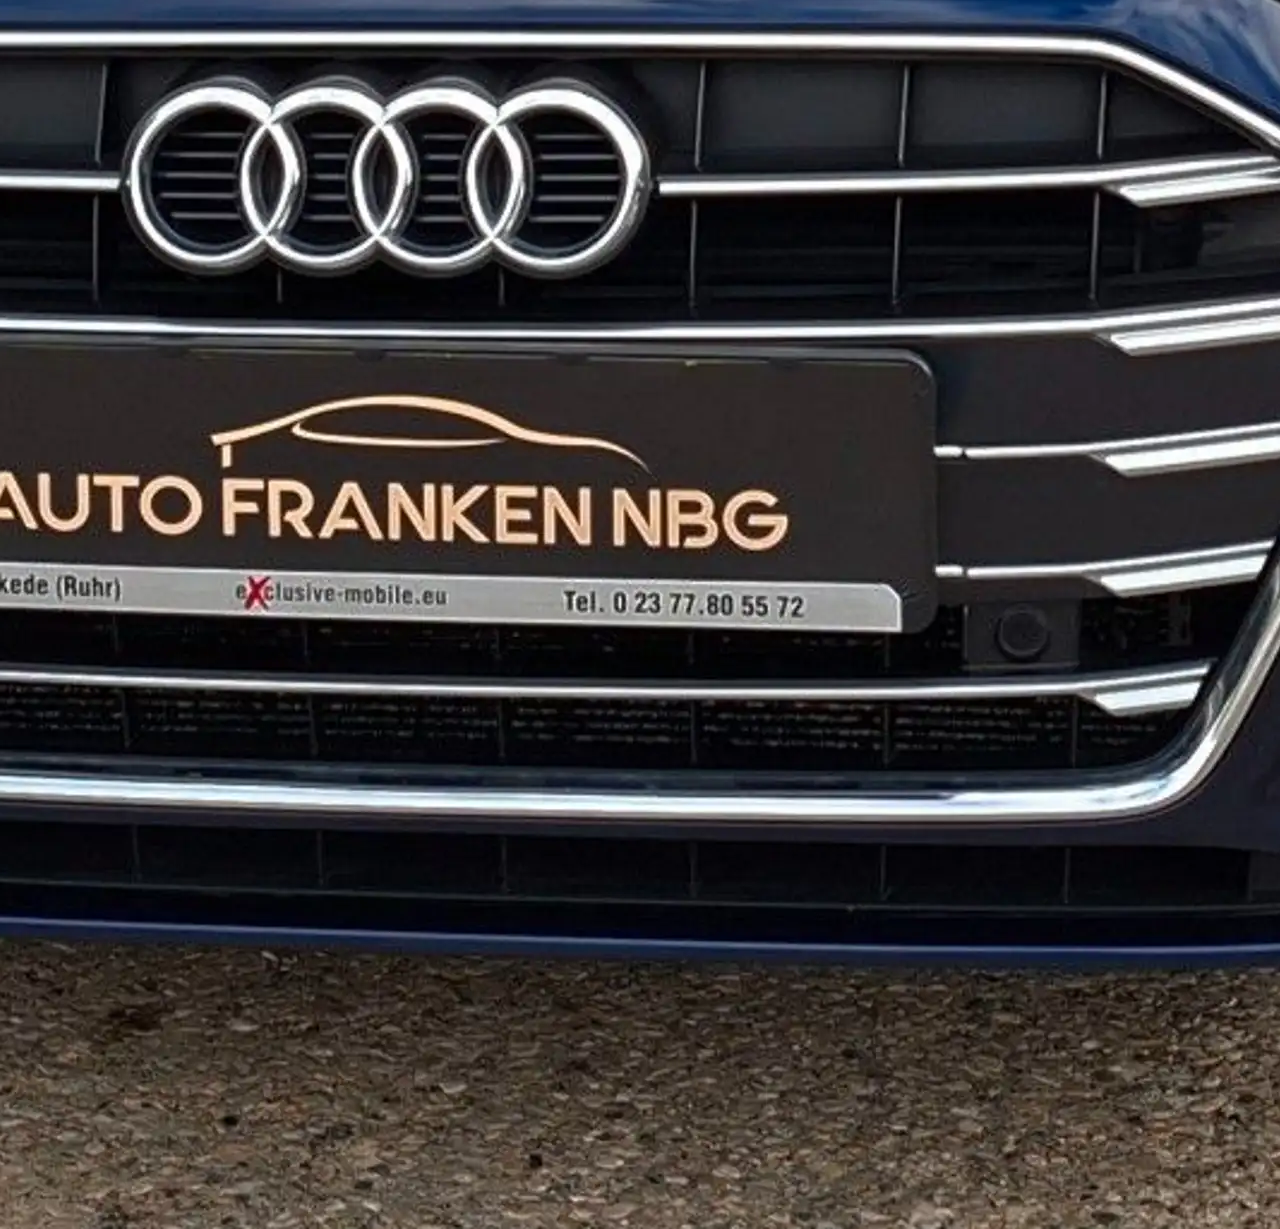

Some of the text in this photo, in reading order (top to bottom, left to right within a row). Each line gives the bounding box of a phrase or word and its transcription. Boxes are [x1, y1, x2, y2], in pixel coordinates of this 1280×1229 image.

[222, 477, 593, 546] FRANKEN
[612, 487, 789, 552] NBG
[56, 574, 121, 603] (Ruhr)
[564, 590, 805, 619] Tel. 0 23 77.80 55 72
